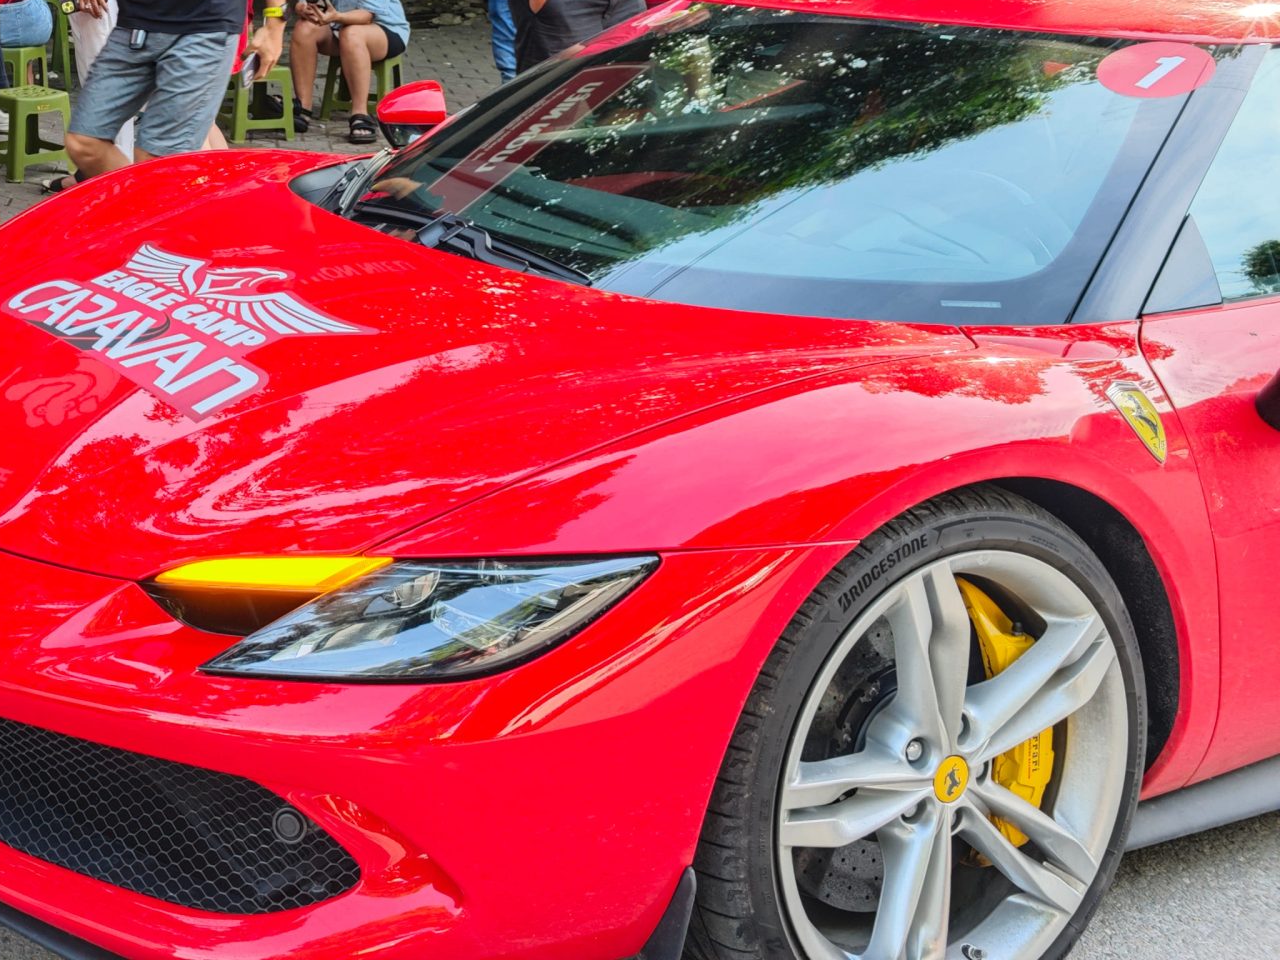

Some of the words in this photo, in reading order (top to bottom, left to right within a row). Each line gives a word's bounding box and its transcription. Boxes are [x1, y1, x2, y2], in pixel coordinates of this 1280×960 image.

[1134, 55, 1187, 89] 1
[7, 279, 260, 416] CARAVAN
[91, 269, 179, 313] EAGLE
[170, 302, 267, 348] CAMP
[837, 534, 929, 615] BRIDGESTONE
